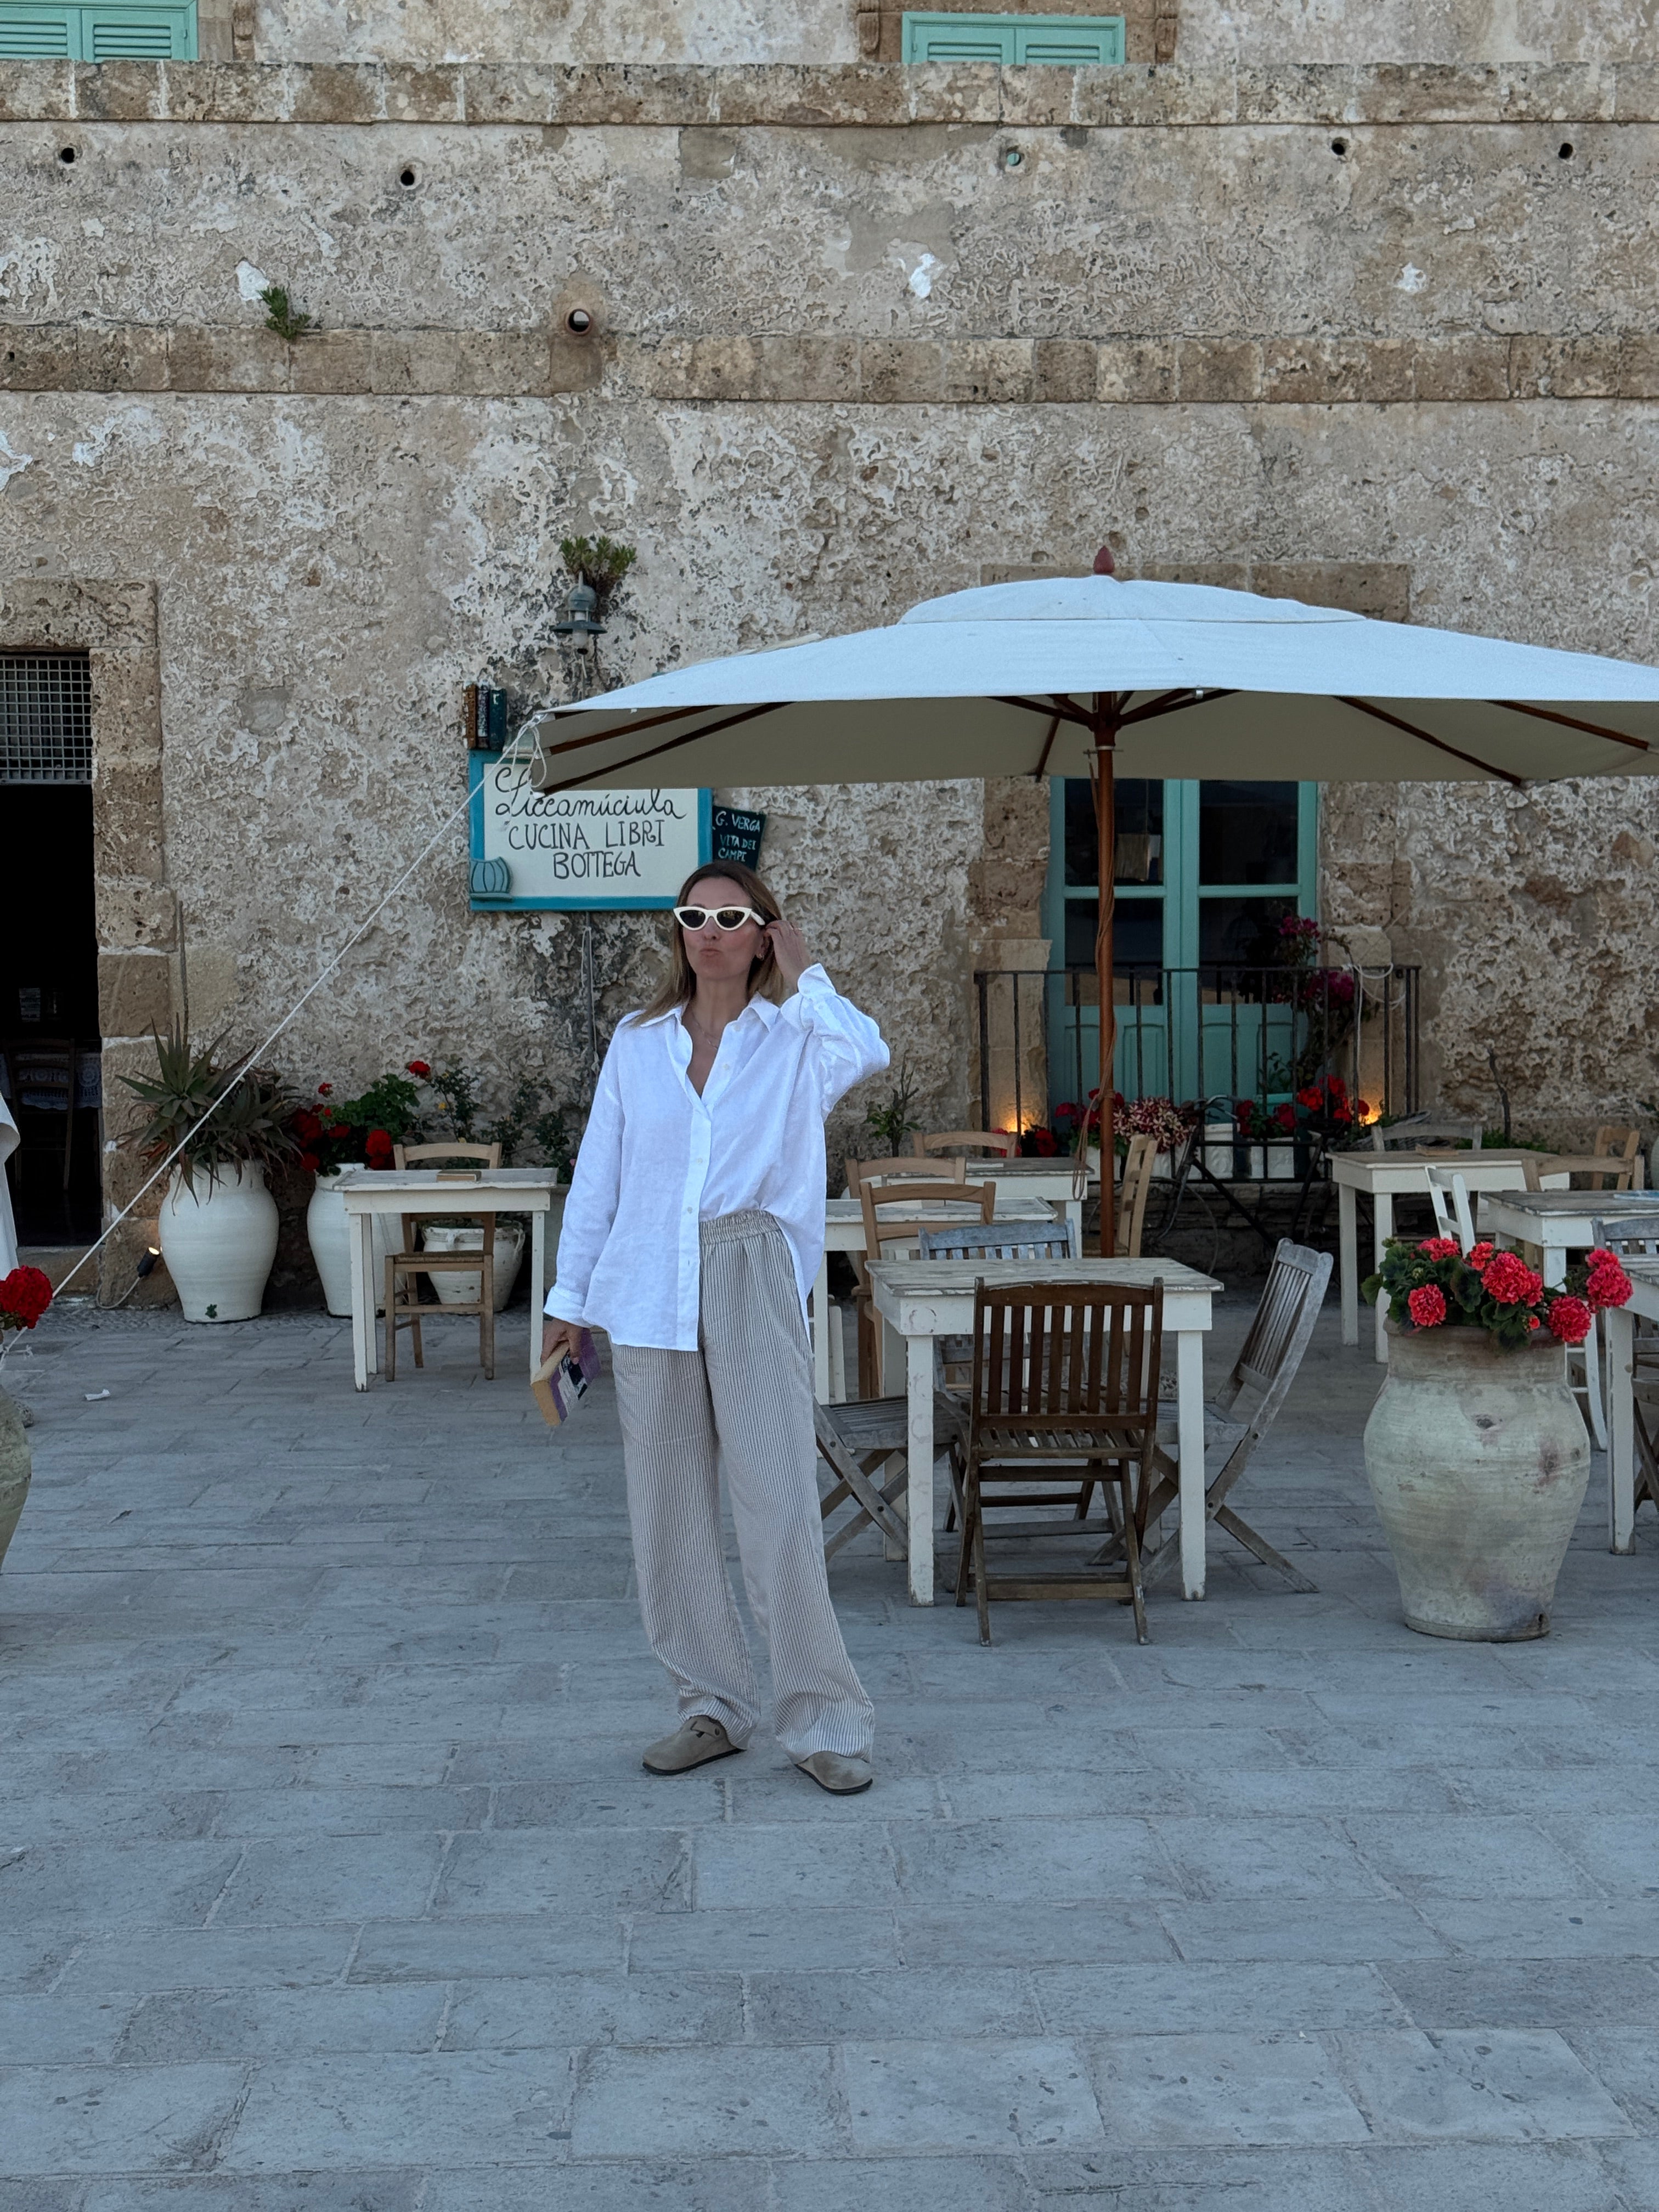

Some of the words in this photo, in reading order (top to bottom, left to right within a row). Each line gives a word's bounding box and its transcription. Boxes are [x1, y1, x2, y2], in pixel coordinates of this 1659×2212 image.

[715, 811, 729, 826] G.
[731, 813, 761, 833] VERGA
[509, 822, 590, 850] CUCINA
[605, 819, 665, 848] LIBRI
[720, 833, 740, 848] VITA
[741, 838, 757, 851] DEI
[553, 850, 641, 879] BOTTEGA
[718, 847, 748, 862] CAMPI
